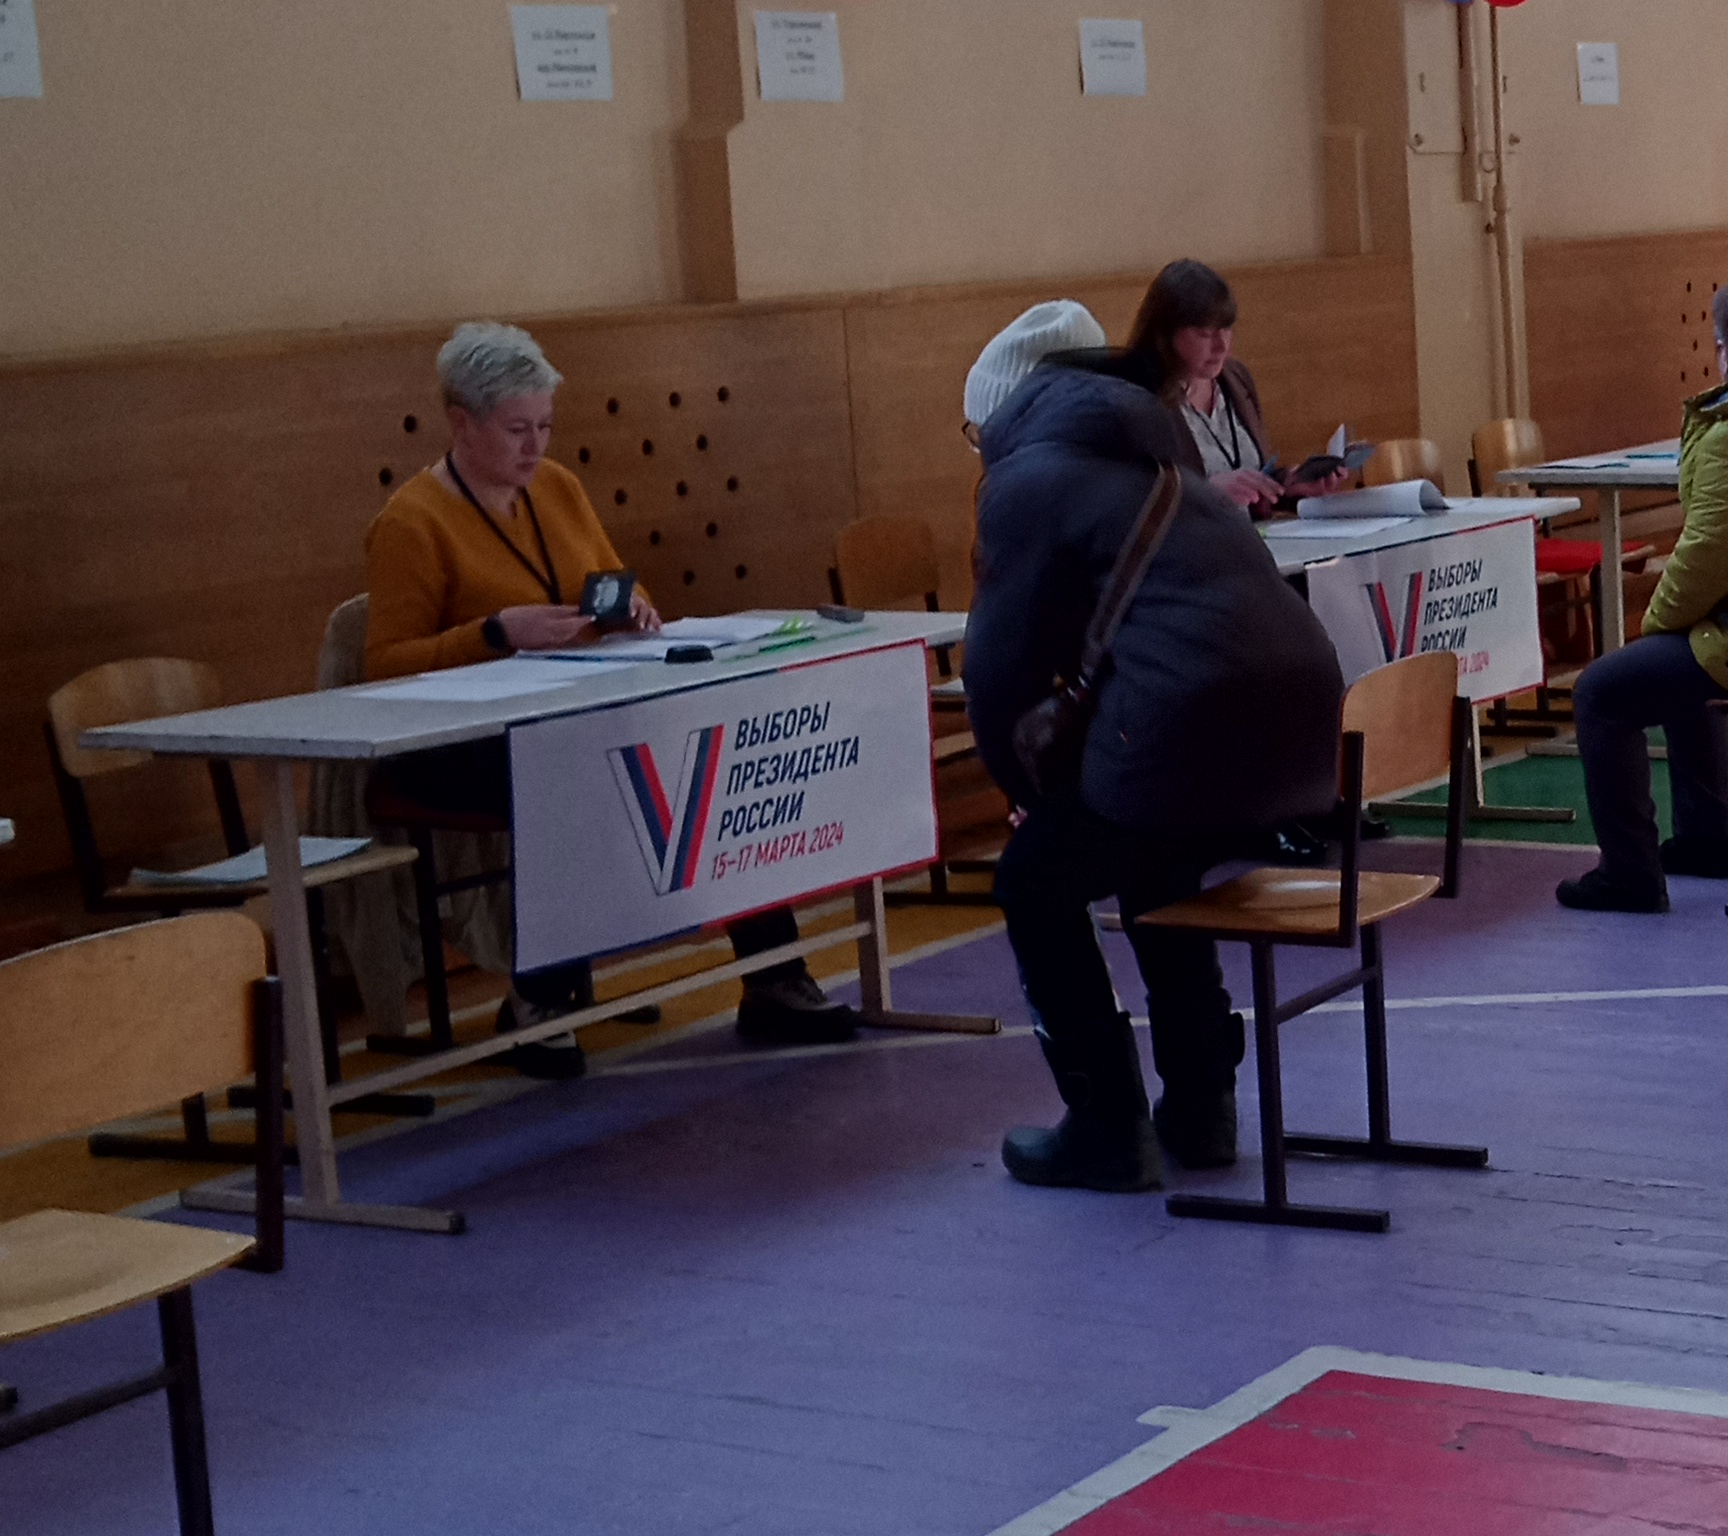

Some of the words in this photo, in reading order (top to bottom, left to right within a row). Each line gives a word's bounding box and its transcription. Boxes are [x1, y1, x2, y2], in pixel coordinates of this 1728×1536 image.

[1428, 558, 1483, 593] ВЫБОРЫ
[1424, 587, 1498, 626] ПРЕЗИДЕНТА
[1421, 626, 1468, 653] РОССИИ
[734, 701, 831, 751] ВЫБОРЫ
[726, 736, 860, 796] ПРЕЗИДЕНТА
[717, 790, 805, 842] РОССИИ
[754, 830, 806, 868] МАРТА
[808, 821, 844, 855] 2024
